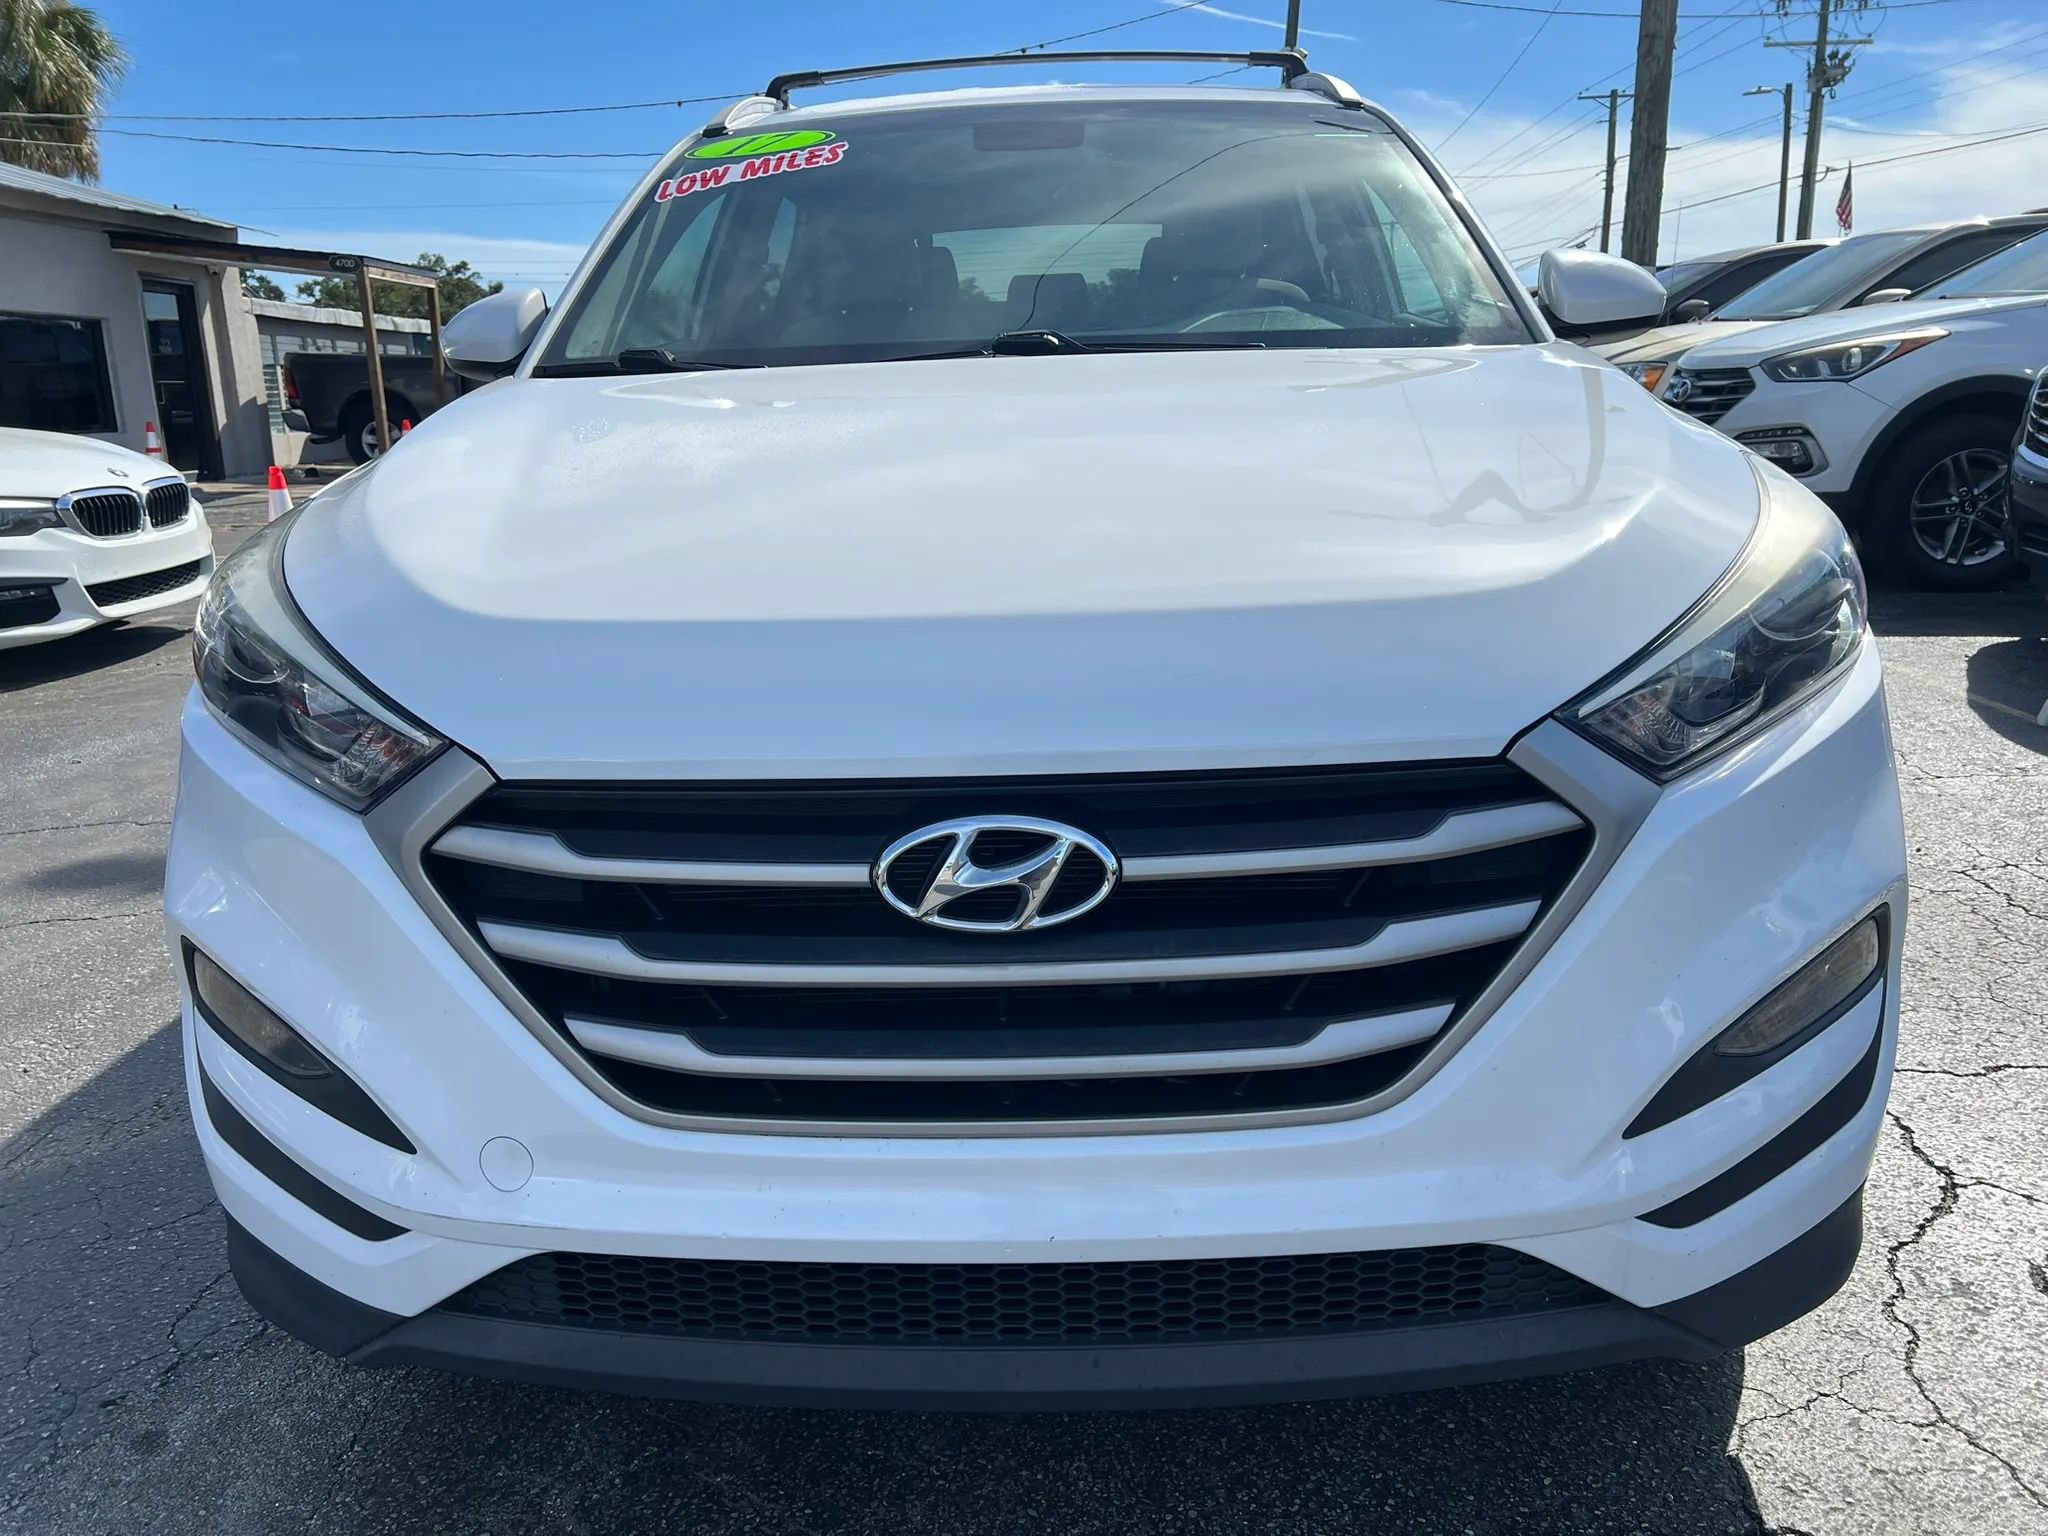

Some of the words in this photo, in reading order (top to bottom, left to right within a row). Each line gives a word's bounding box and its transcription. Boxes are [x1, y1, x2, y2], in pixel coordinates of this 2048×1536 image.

[657, 165, 731, 201] LOW
[739, 142, 848, 180] MILES
[335, 258, 356, 268] 4700
